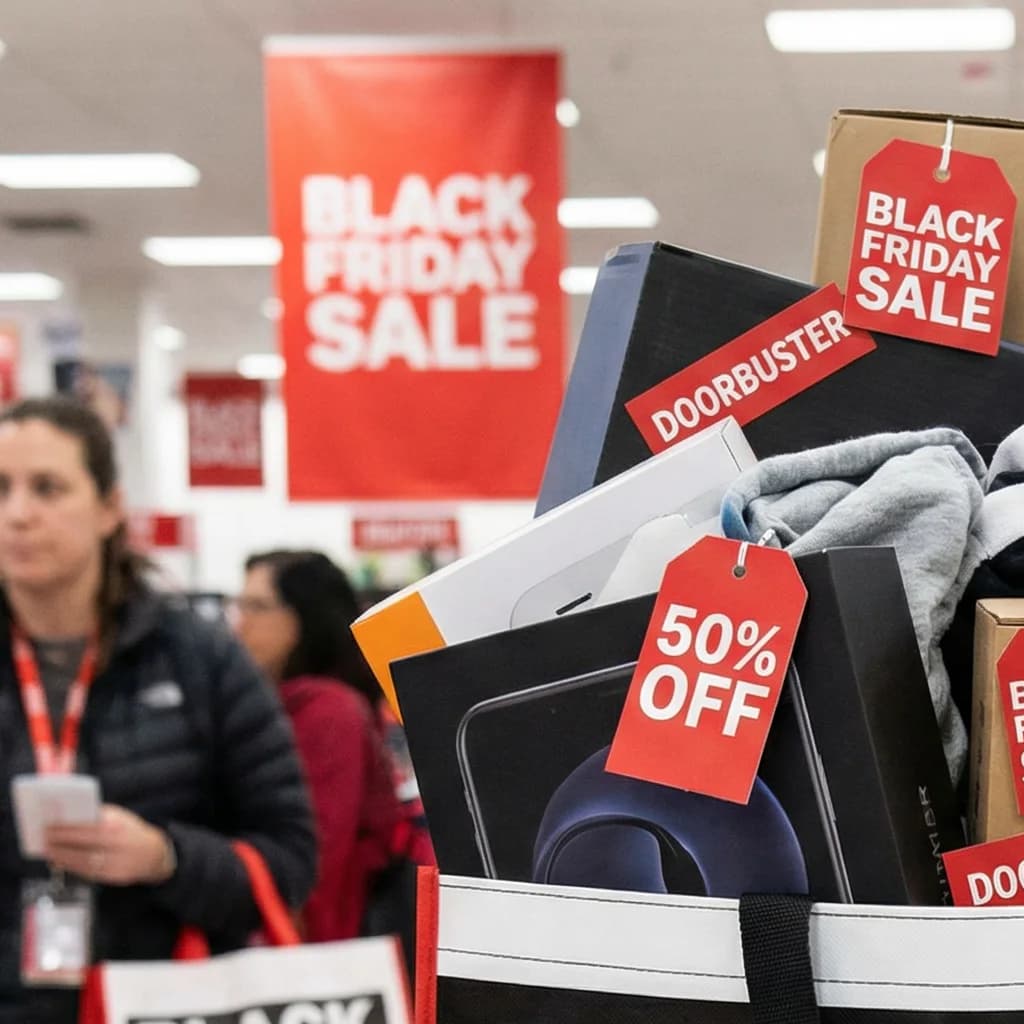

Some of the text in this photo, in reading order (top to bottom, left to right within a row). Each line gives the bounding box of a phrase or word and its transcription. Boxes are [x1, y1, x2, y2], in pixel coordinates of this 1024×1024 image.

[301, 174, 533, 236] BLACK
[867, 192, 1003, 249] BLACK
[304, 236, 535, 294] FRIDAY
[862, 229, 1000, 282] FRIDAY
[856, 267, 994, 332] SALE
[307, 296, 539, 372] SALE
[652, 311, 850, 442] DOORBUSTER
[657, 604, 780, 676] 50%
[640, 665, 769, 736] OFF
